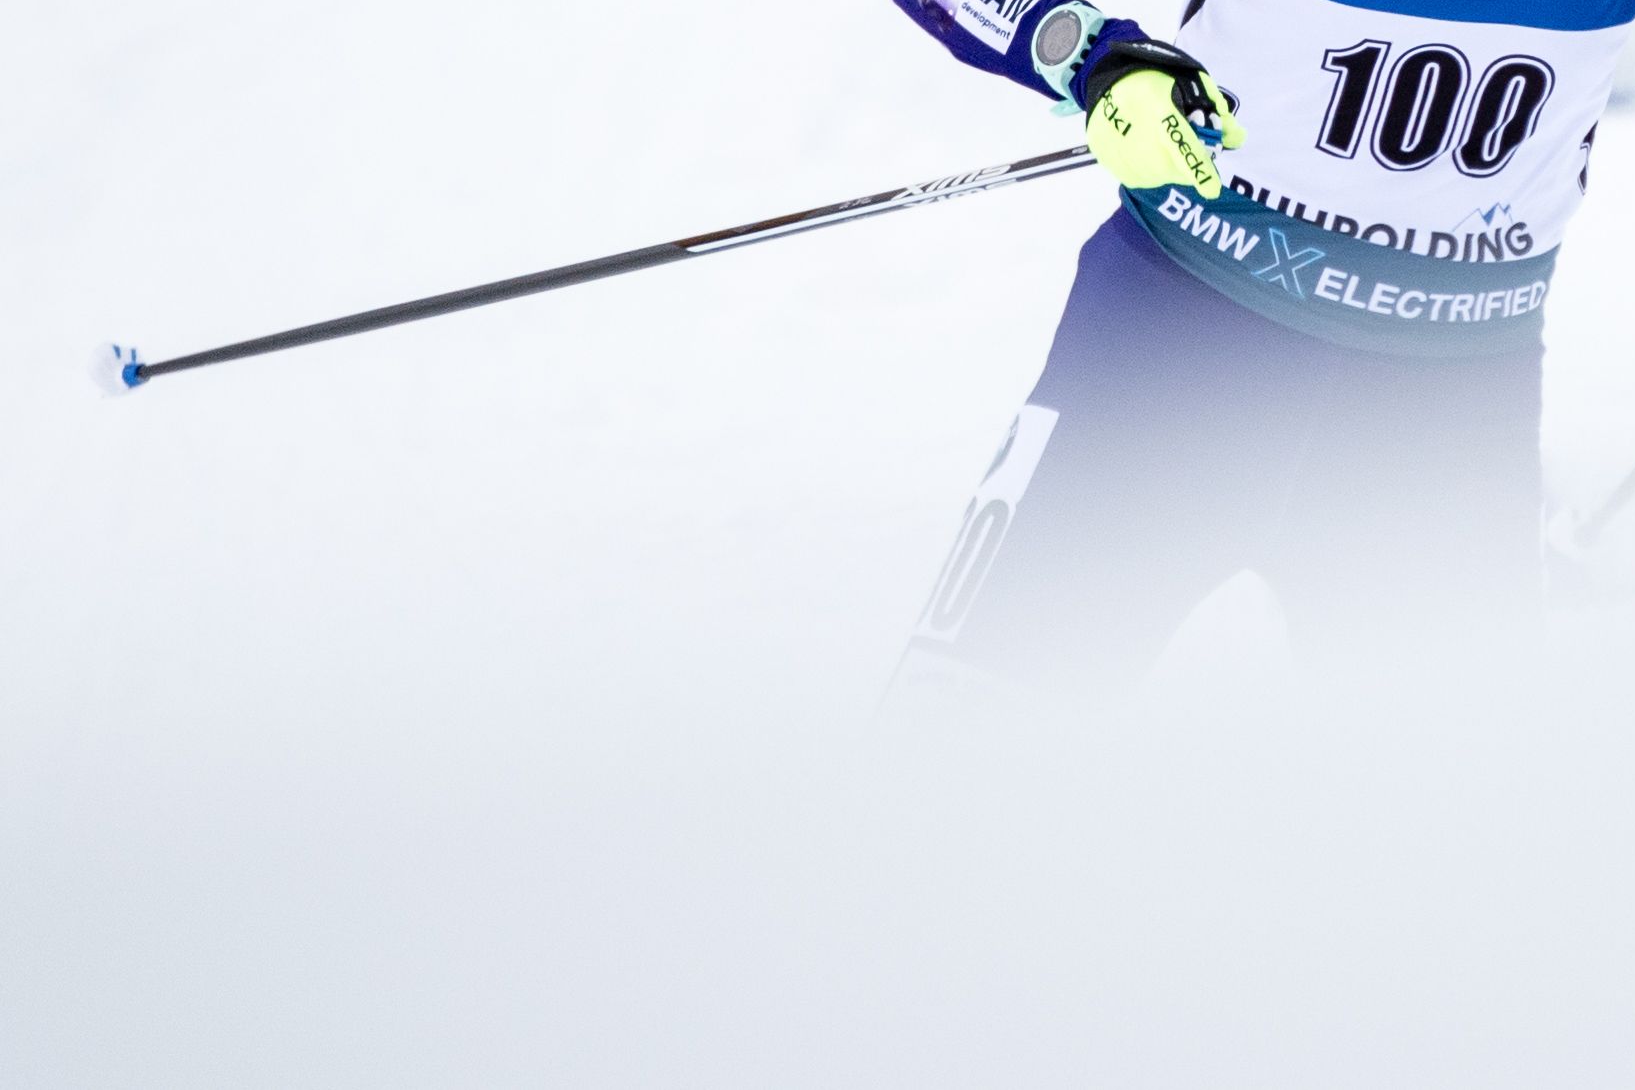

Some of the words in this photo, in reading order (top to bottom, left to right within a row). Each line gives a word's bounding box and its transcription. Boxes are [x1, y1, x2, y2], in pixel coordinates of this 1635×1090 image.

[961, 1, 1011, 40] development
[1315, 38, 1555, 179] 100
[1157, 188, 1260, 262] BMW
[1314, 267, 1547, 323] ELECTRIFIED
